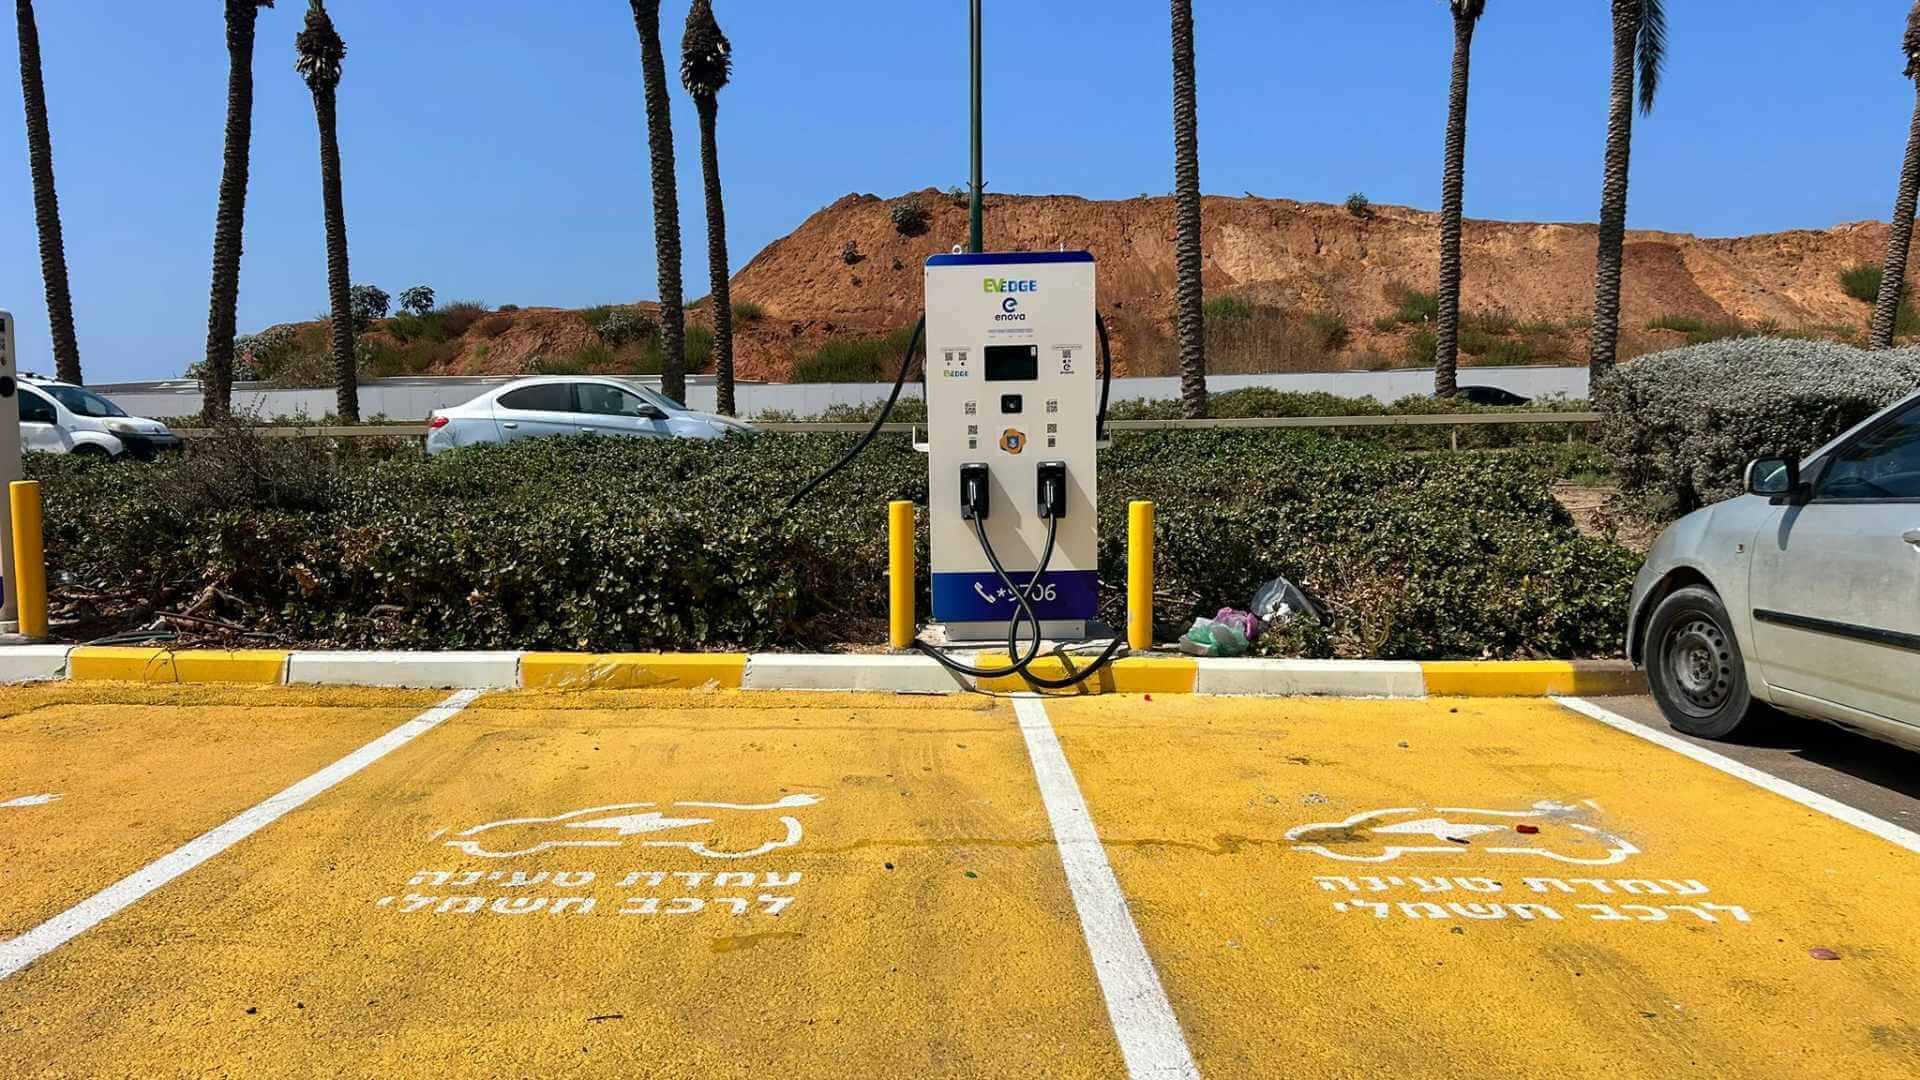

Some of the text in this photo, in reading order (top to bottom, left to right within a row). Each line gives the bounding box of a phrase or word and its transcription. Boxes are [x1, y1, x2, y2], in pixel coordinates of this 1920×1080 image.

[994, 313, 1026, 321] enova
[405, 869, 802, 888] עמדת טעינה
[1312, 875, 1710, 895] עמדת טעינה
[376, 893, 797, 915] לרכב חשמלי
[1333, 899, 1751, 921] לרכב חשמלי
